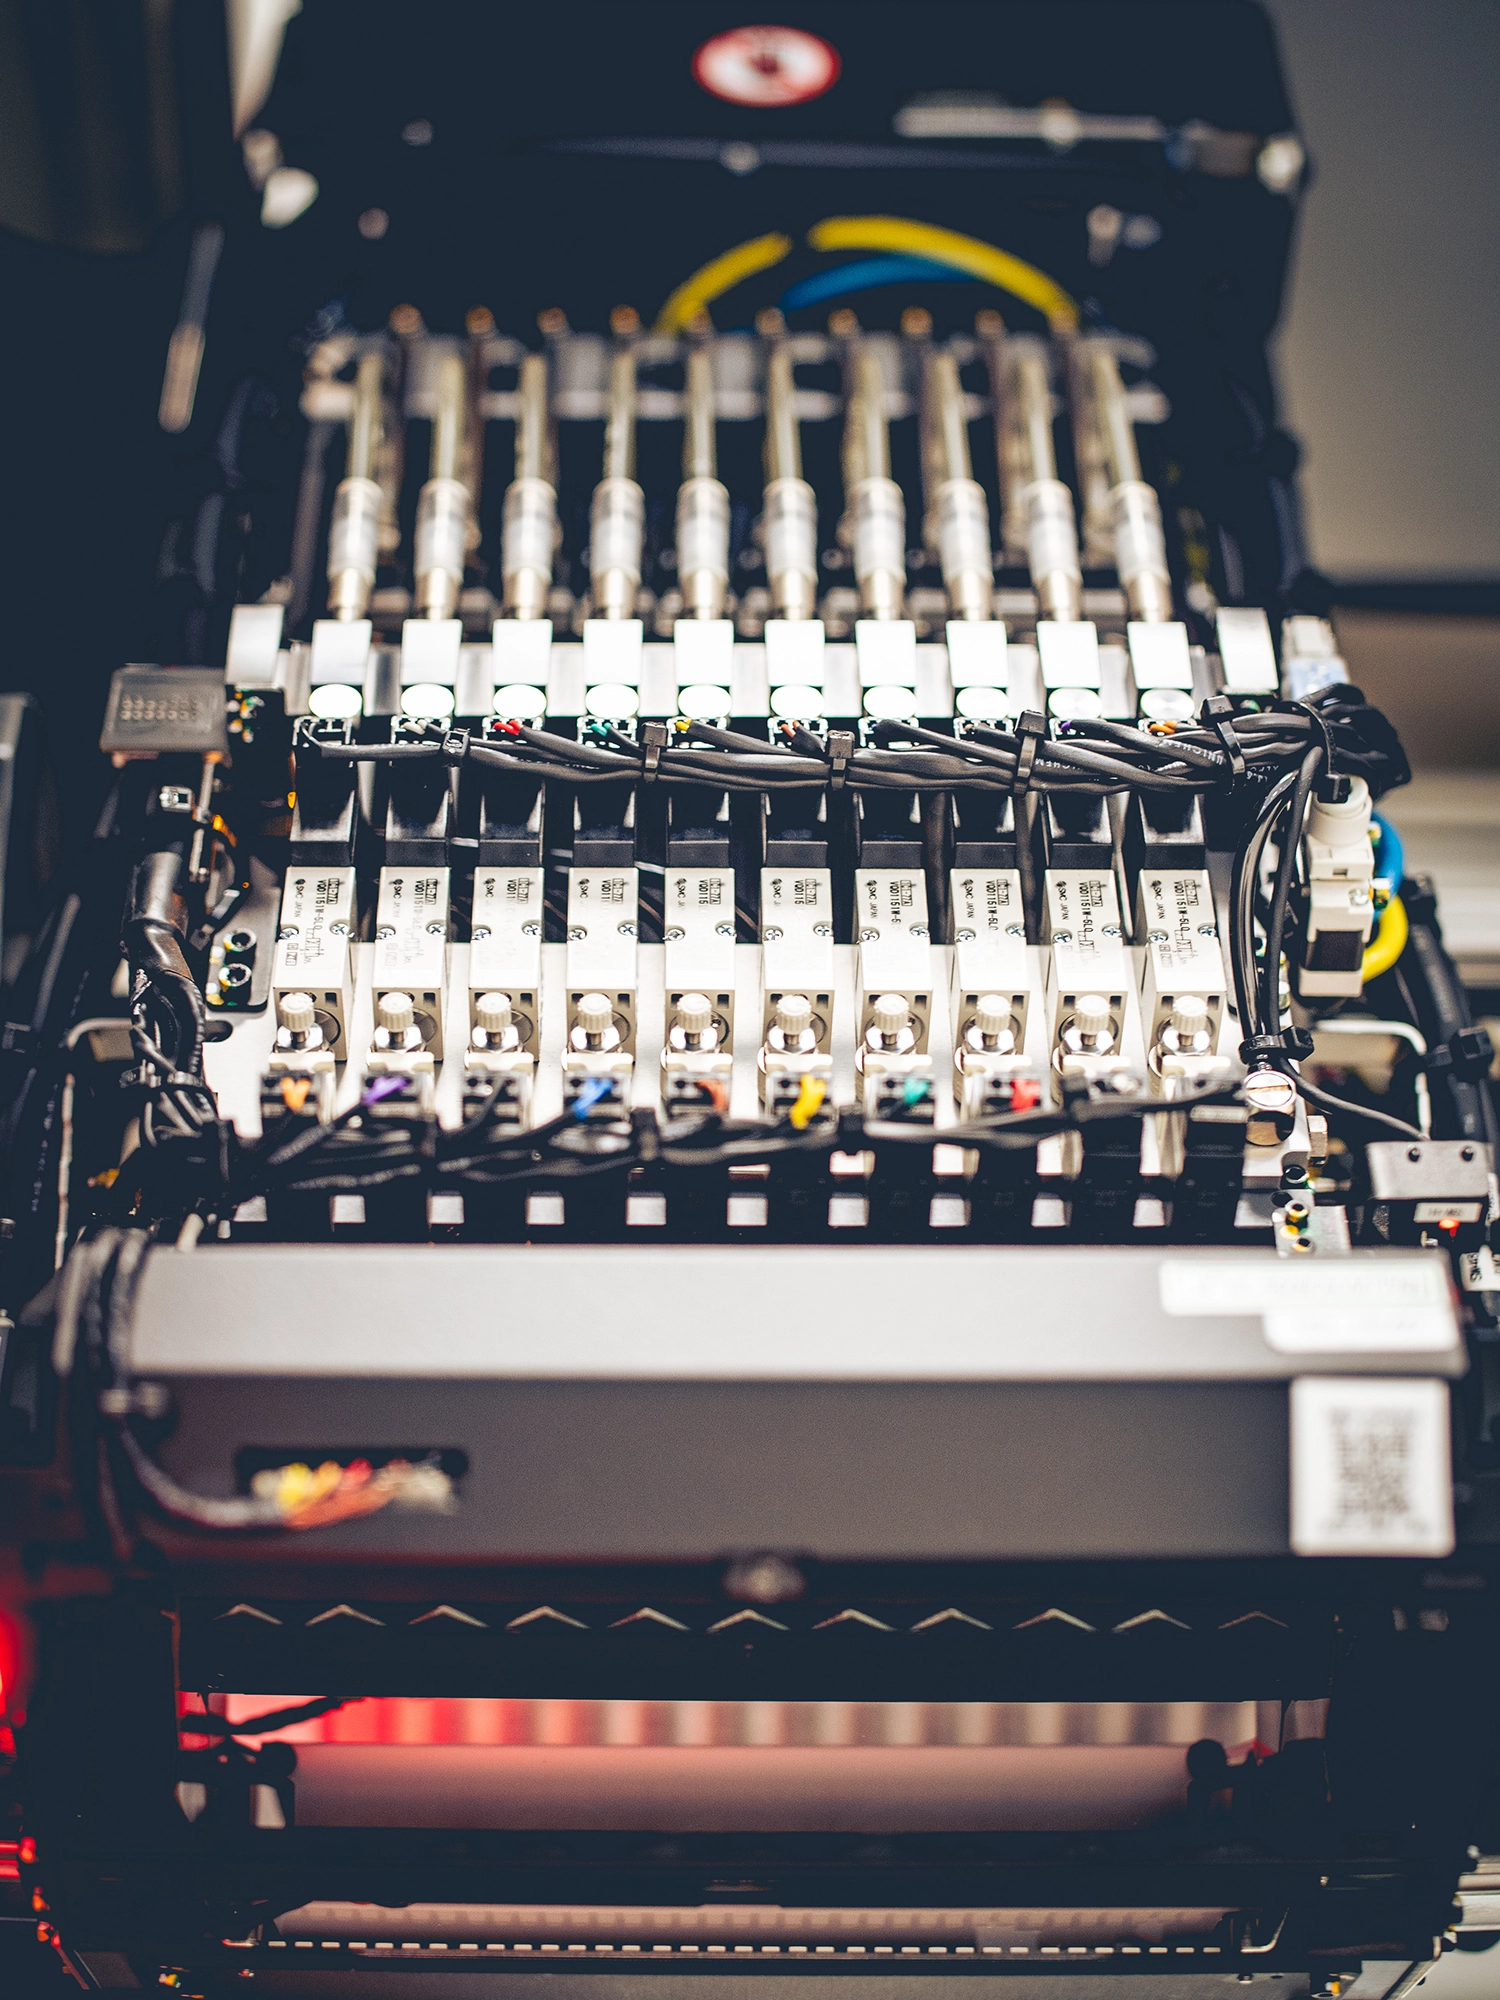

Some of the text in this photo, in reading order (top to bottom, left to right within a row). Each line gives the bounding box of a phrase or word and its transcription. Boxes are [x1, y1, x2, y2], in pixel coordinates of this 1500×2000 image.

[294, 886, 303, 917] SMC JAPAN
[393, 886, 402, 899] SMC
[485, 885, 494, 898] SMC
[579, 886, 588, 898] SMC
[677, 886, 686, 898] SMC
[773, 886, 781, 898] SMC
[965, 887, 974, 918] SMC JAPAN
[868, 887, 878, 919] SMC JAPAN
[1058, 888, 1069, 920] SMC JAPAN
[1154, 887, 1165, 919] SMC JAPAN
